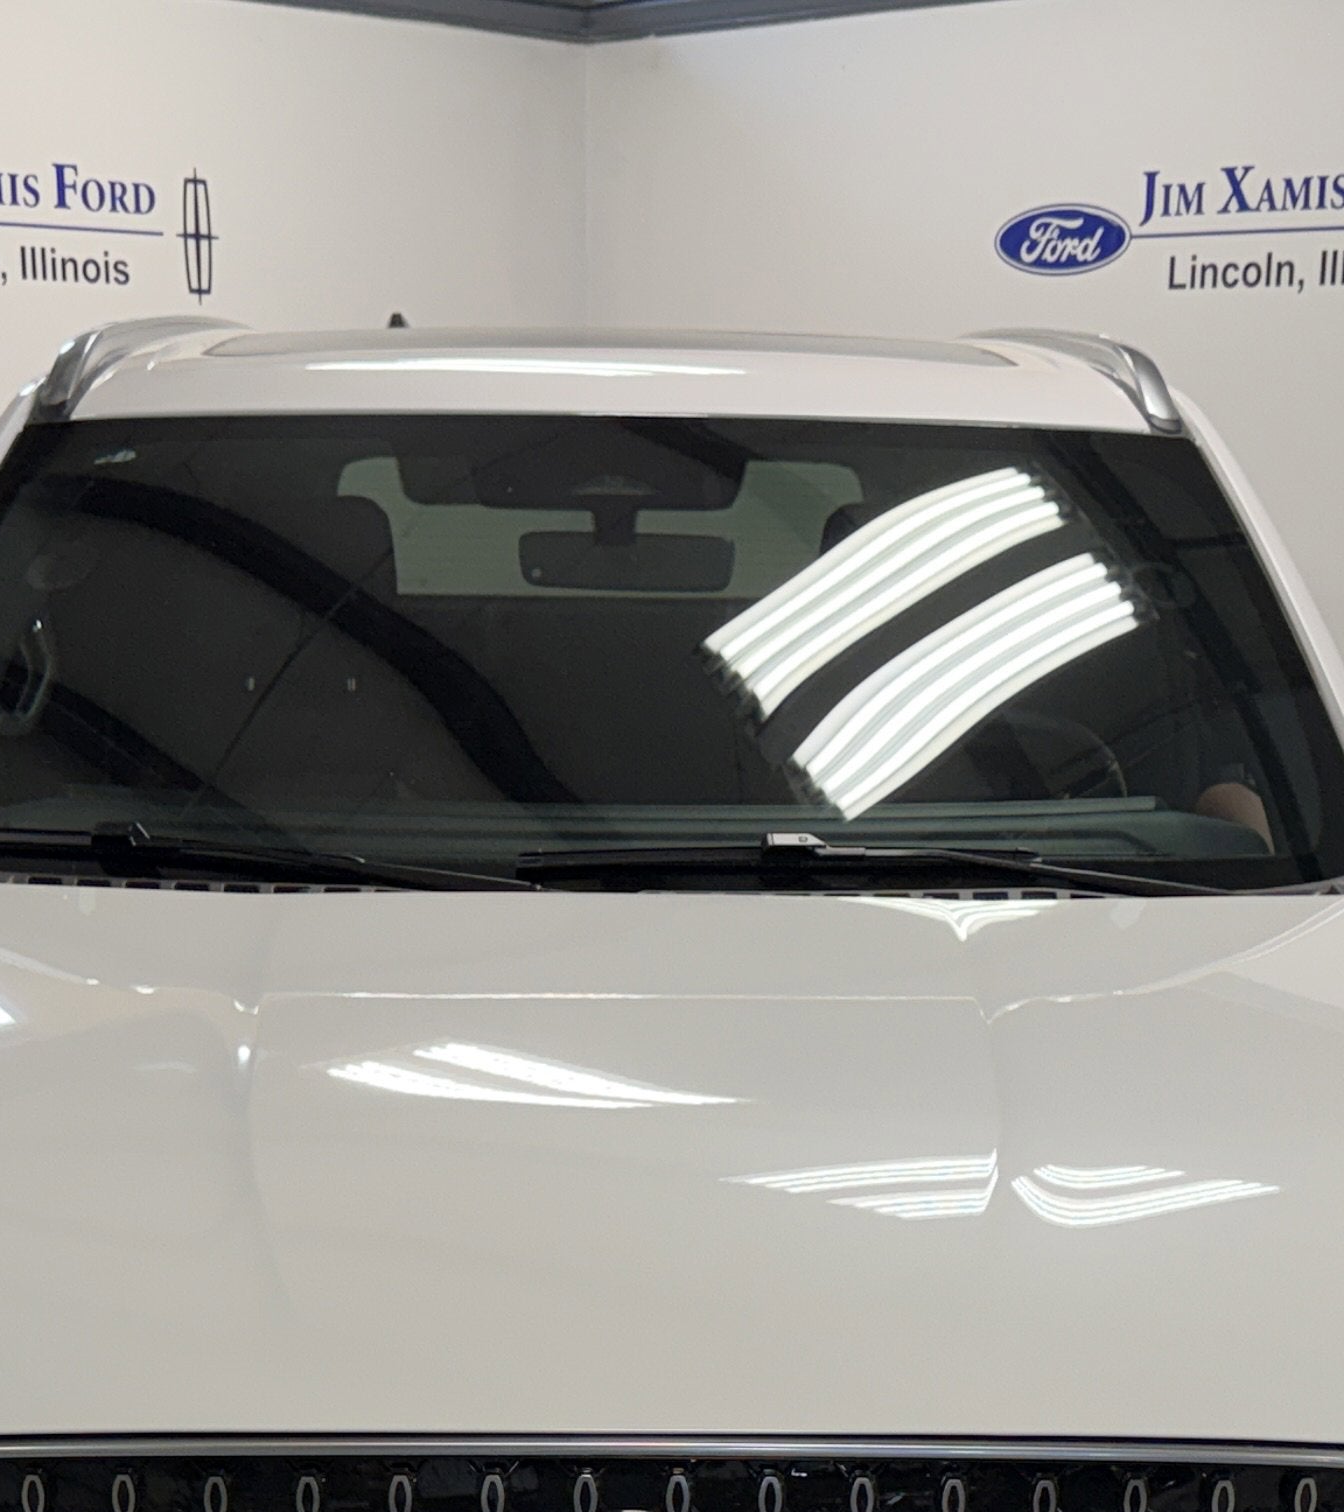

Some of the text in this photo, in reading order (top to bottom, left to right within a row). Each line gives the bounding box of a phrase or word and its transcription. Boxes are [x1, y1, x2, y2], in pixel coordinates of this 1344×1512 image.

[52, 162, 156, 216] FORD
[1139, 169, 1206, 226] JIM
[19, 245, 131, 285] Illinois
[1019, 215, 1101, 265] Ford
[1168, 253, 1305, 294] Lincoln,
